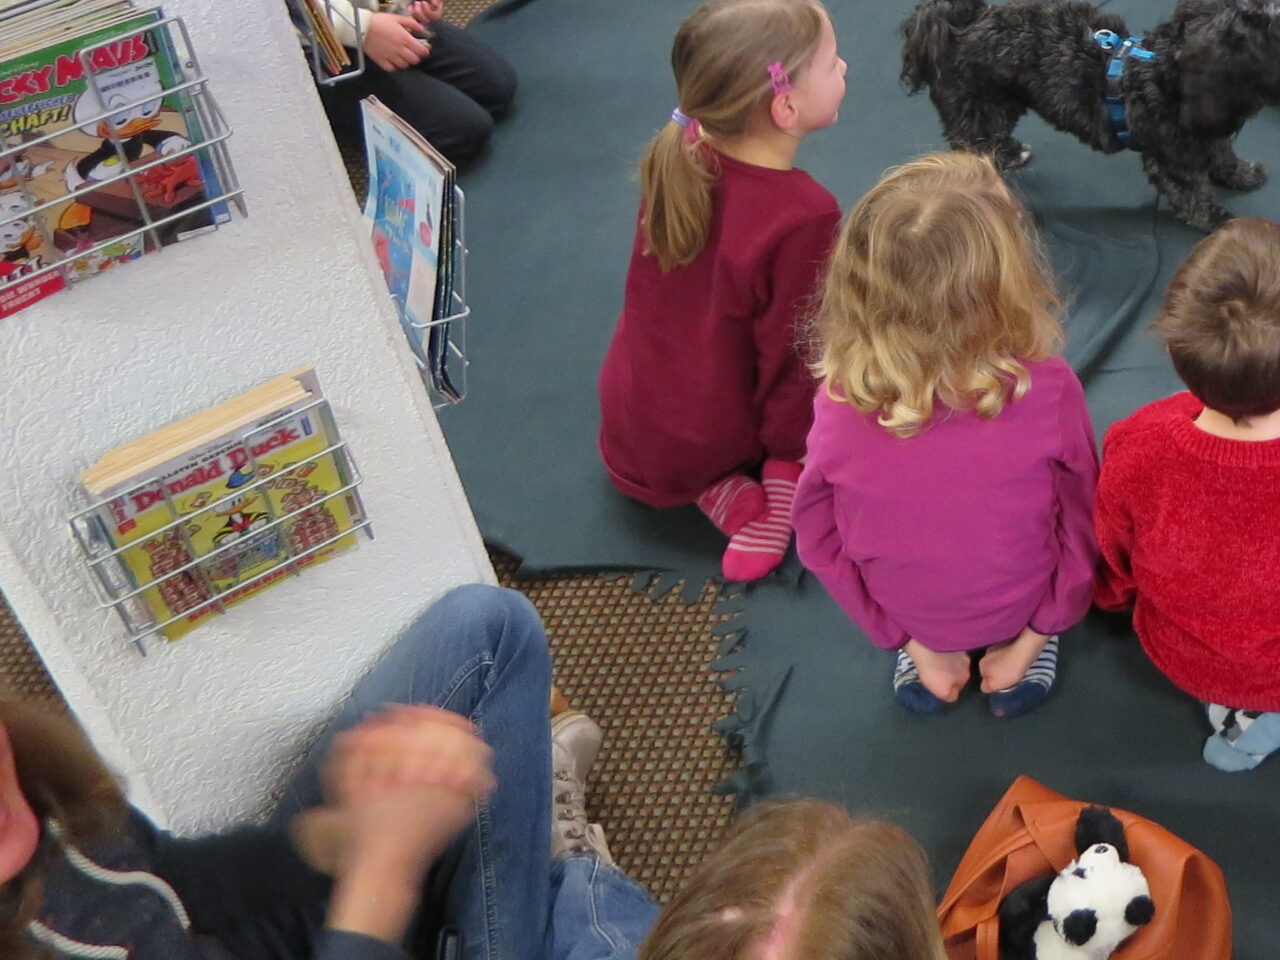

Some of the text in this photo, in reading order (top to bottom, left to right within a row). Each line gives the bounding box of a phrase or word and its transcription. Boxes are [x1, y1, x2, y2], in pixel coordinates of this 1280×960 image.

[0, 65, 54, 104] CKY
[55, 31, 149, 87] MAUS
[131, 457, 227, 513] Donald
[226, 426, 302, 471] Duck
